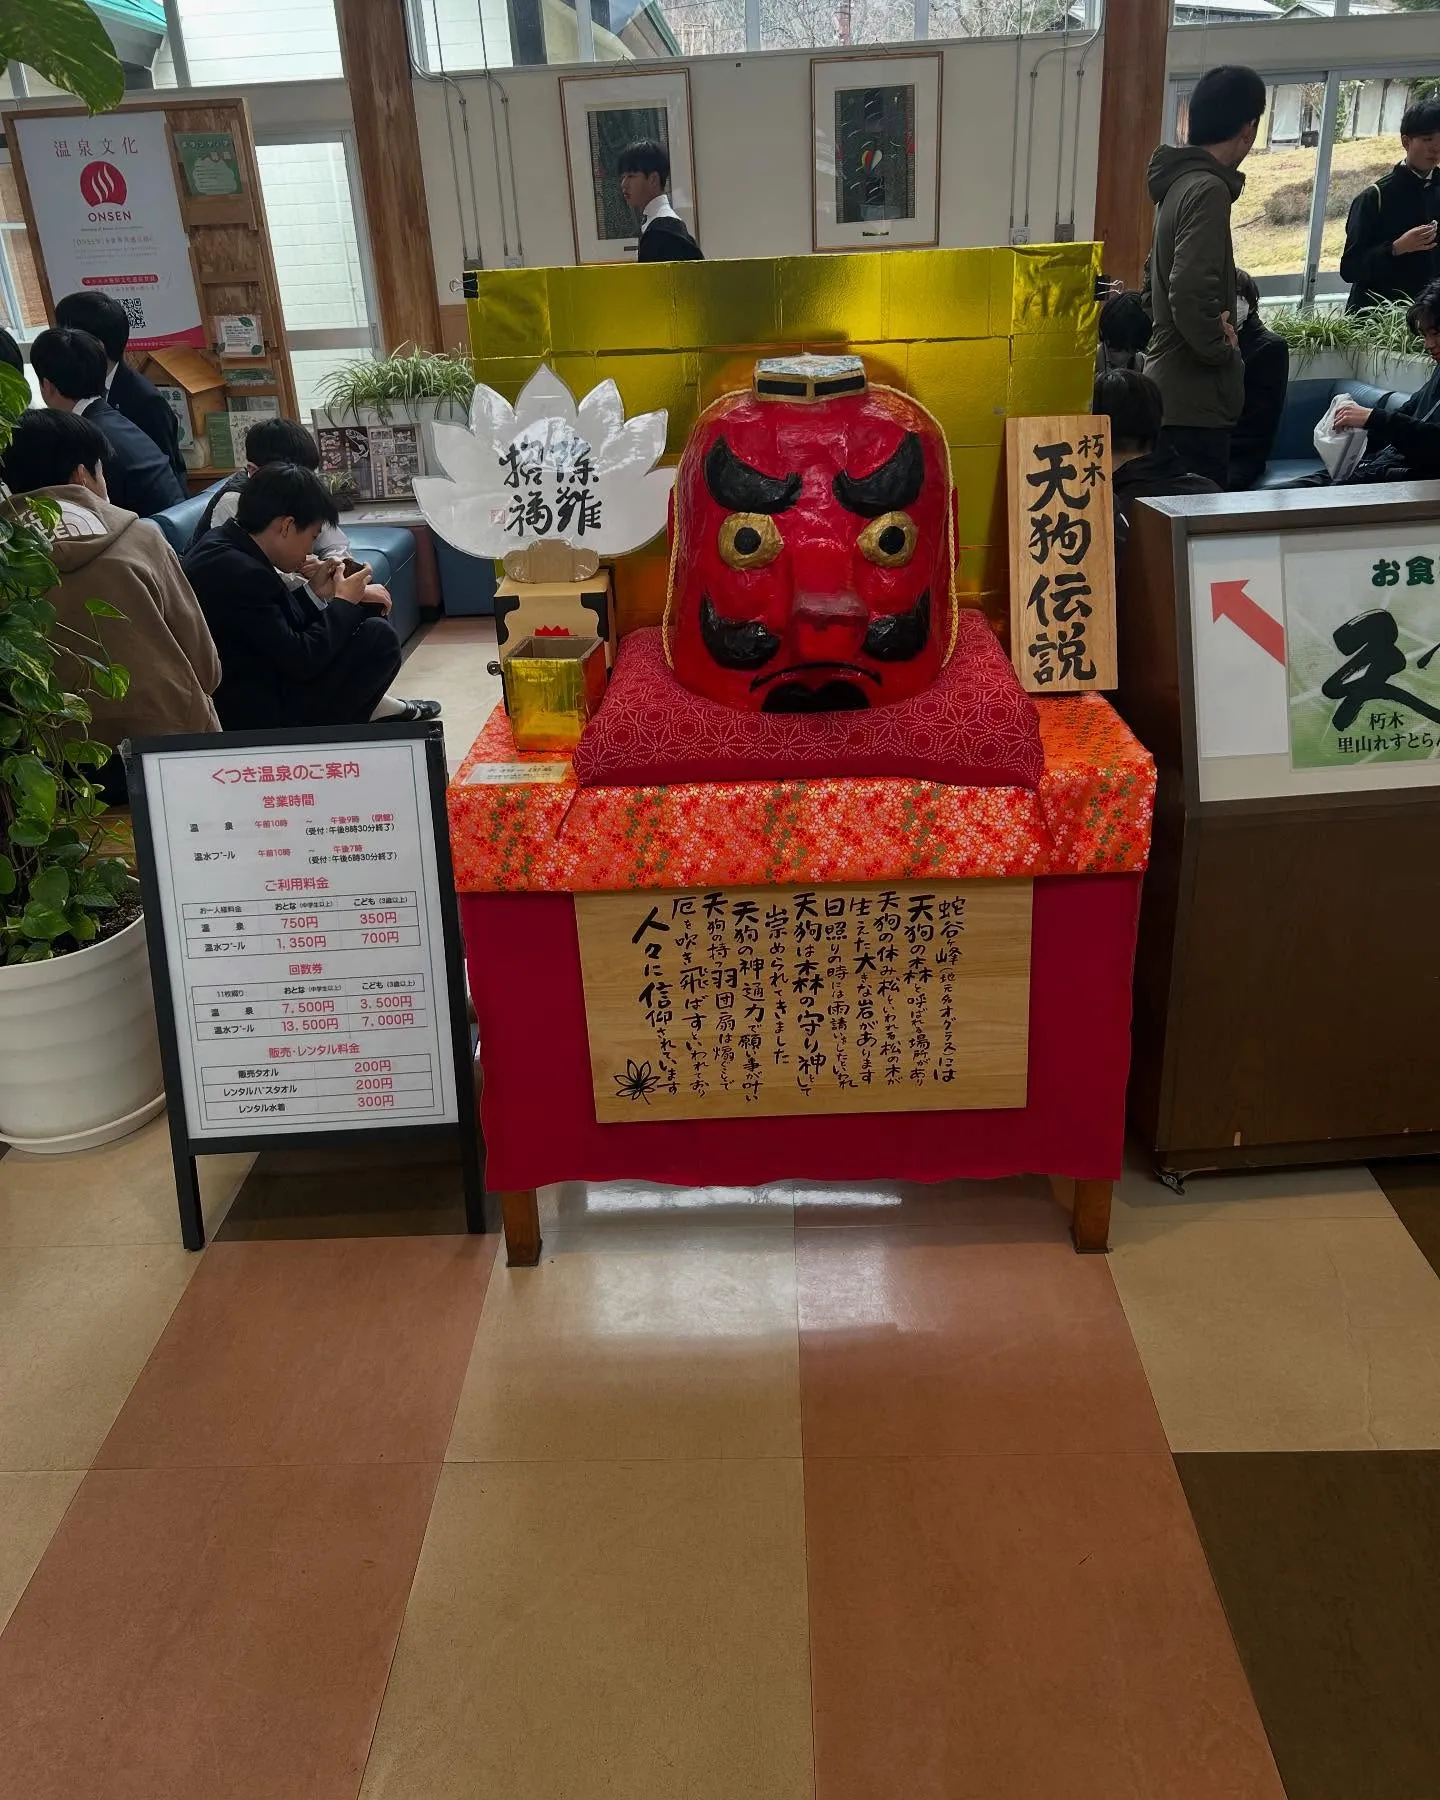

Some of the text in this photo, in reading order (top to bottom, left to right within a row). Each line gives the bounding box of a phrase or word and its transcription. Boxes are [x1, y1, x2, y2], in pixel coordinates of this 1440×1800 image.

[54, 136, 139, 158] 温泉文化
[88, 211, 132, 222] ONSEN
[1078, 434, 1106, 487] 朽木
[1026, 441, 1097, 686] 天狗伝説
[1371, 555, 1440, 588] お食
[1368, 711, 1405, 731] 朽木
[1337, 732, 1440, 754] 里山れすとら
[211, 761, 361, 785] くつき温泉のご案内
[262, 793, 315, 809] 営業時間
[254, 819, 288, 829] 午前10時
[331, 815, 360, 825] 午後9時
[258, 848, 291, 858] 午前10時
[333, 844, 363, 854] 午後7時
[265, 876, 330, 892] ご利用料金
[281, 916, 319, 929] 750円
[360, 911, 397, 924] 350円
[361, 931, 400, 945] 700円
[289, 963, 323, 976] 回数券
[764, 903, 790, 1065] 崇められてきました
[792, 891, 827, 1097] 天狗は森の守り神として
[849, 896, 879, 1085] 生えた大きな岩があります
[631, 906, 681, 1095] 人々に信仰されています
[268, 1043, 361, 1059] 販売・レンタル料金
[238, 1059, 392, 1078] 販売タオル 200円
[356, 1077, 393, 1090] 200円
[238, 1094, 394, 1114] レンタル水着 300円
